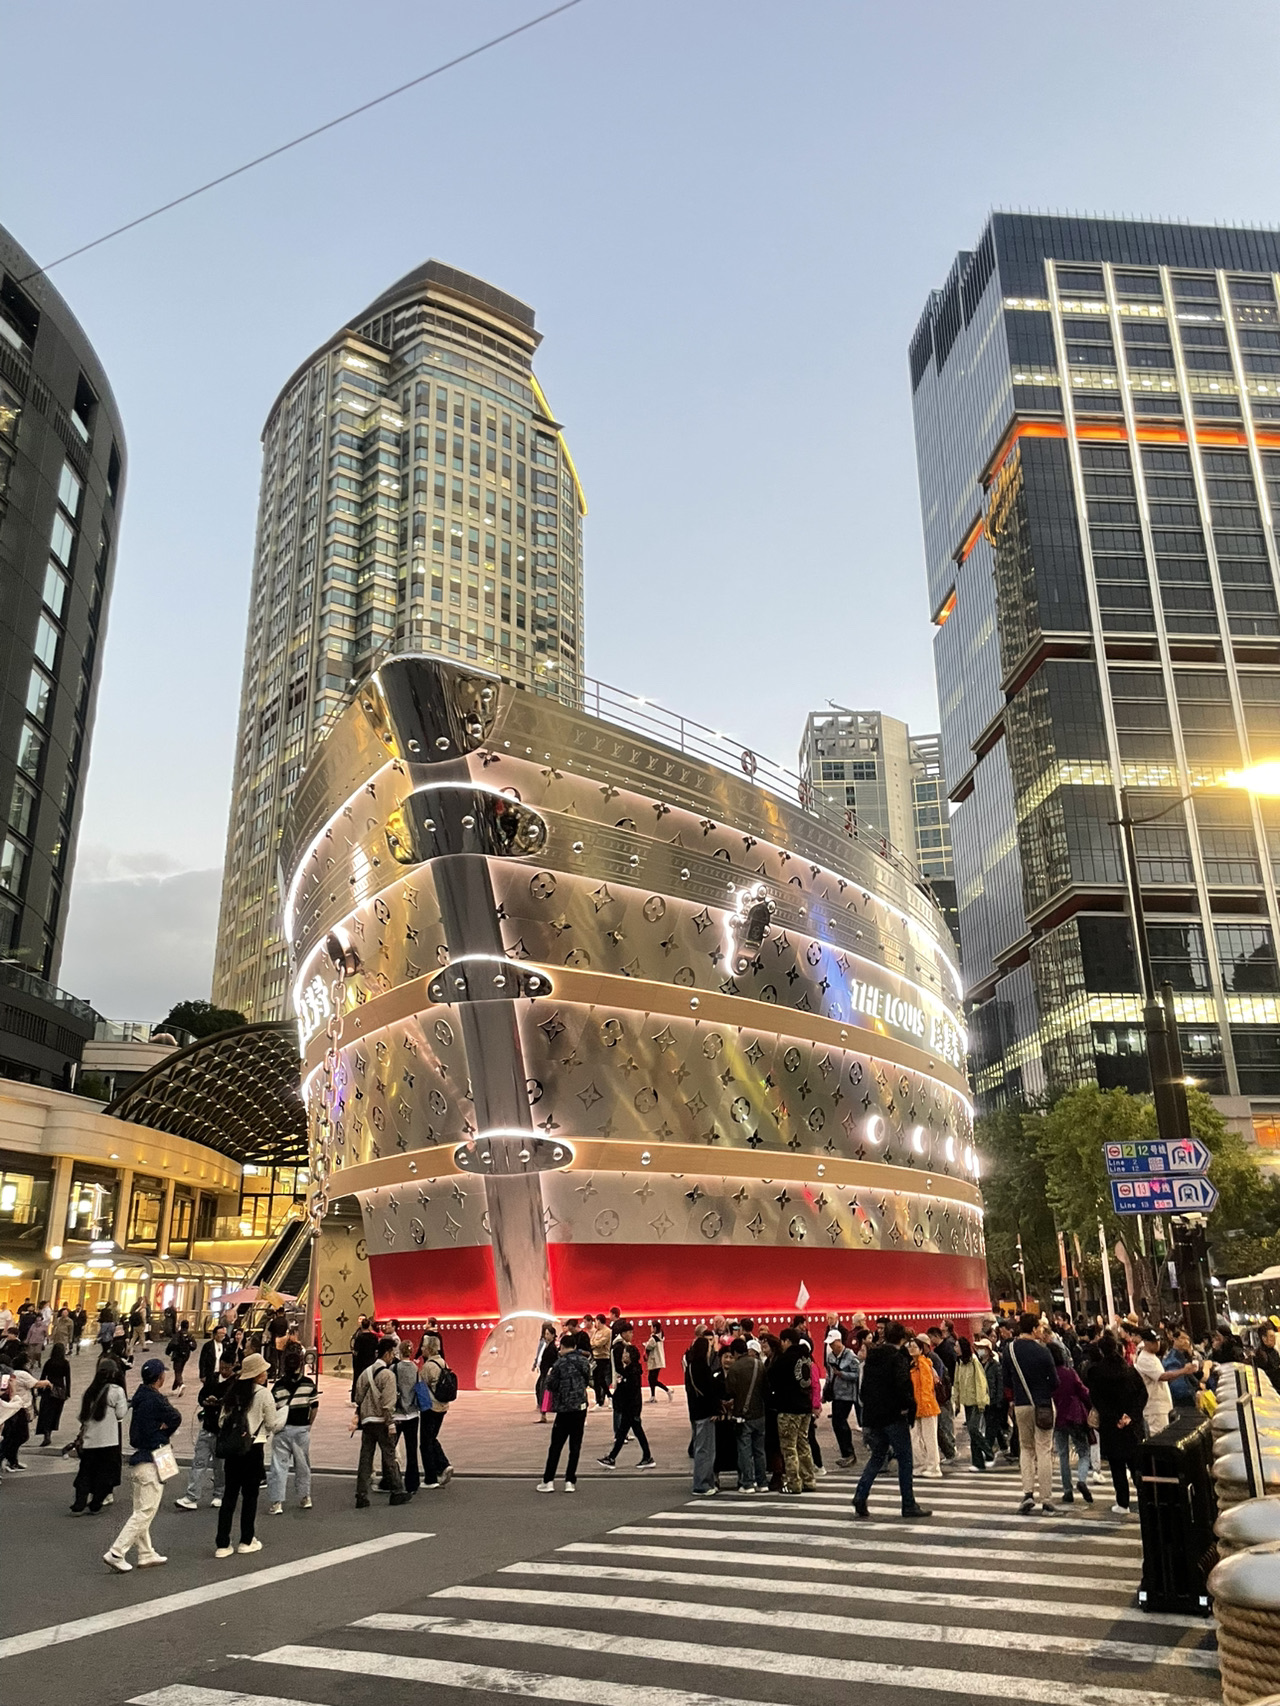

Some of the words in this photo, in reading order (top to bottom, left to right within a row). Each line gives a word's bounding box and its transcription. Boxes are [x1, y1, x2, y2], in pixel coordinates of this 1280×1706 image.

[851, 979, 883, 1019] THE
[884, 993, 926, 1038] LOUIS
[1126, 1145, 1133, 1156] 2
[1137, 1145, 1149, 1156] 12
[1137, 1183, 1147, 1195] 13
